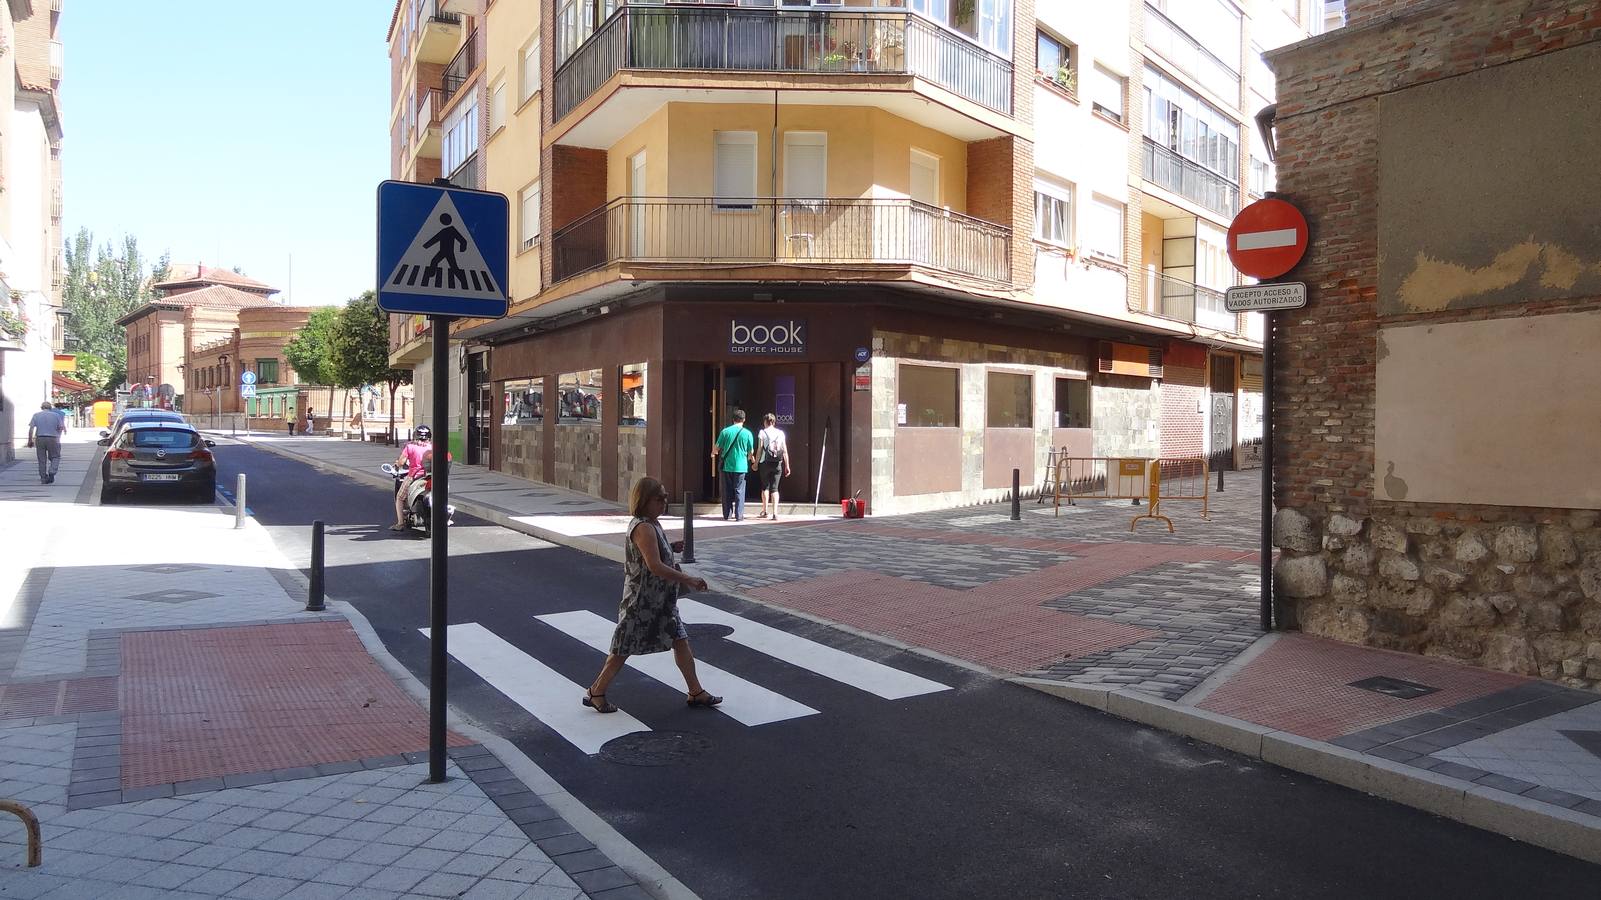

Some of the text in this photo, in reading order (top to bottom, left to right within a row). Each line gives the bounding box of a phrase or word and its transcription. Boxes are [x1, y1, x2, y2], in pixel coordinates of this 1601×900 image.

[1231, 287, 1299, 299] EXCEPTO ACCESO A
[1228, 296, 1302, 307] VADOS AUTORIZADOS
[731, 320, 803, 344] book
